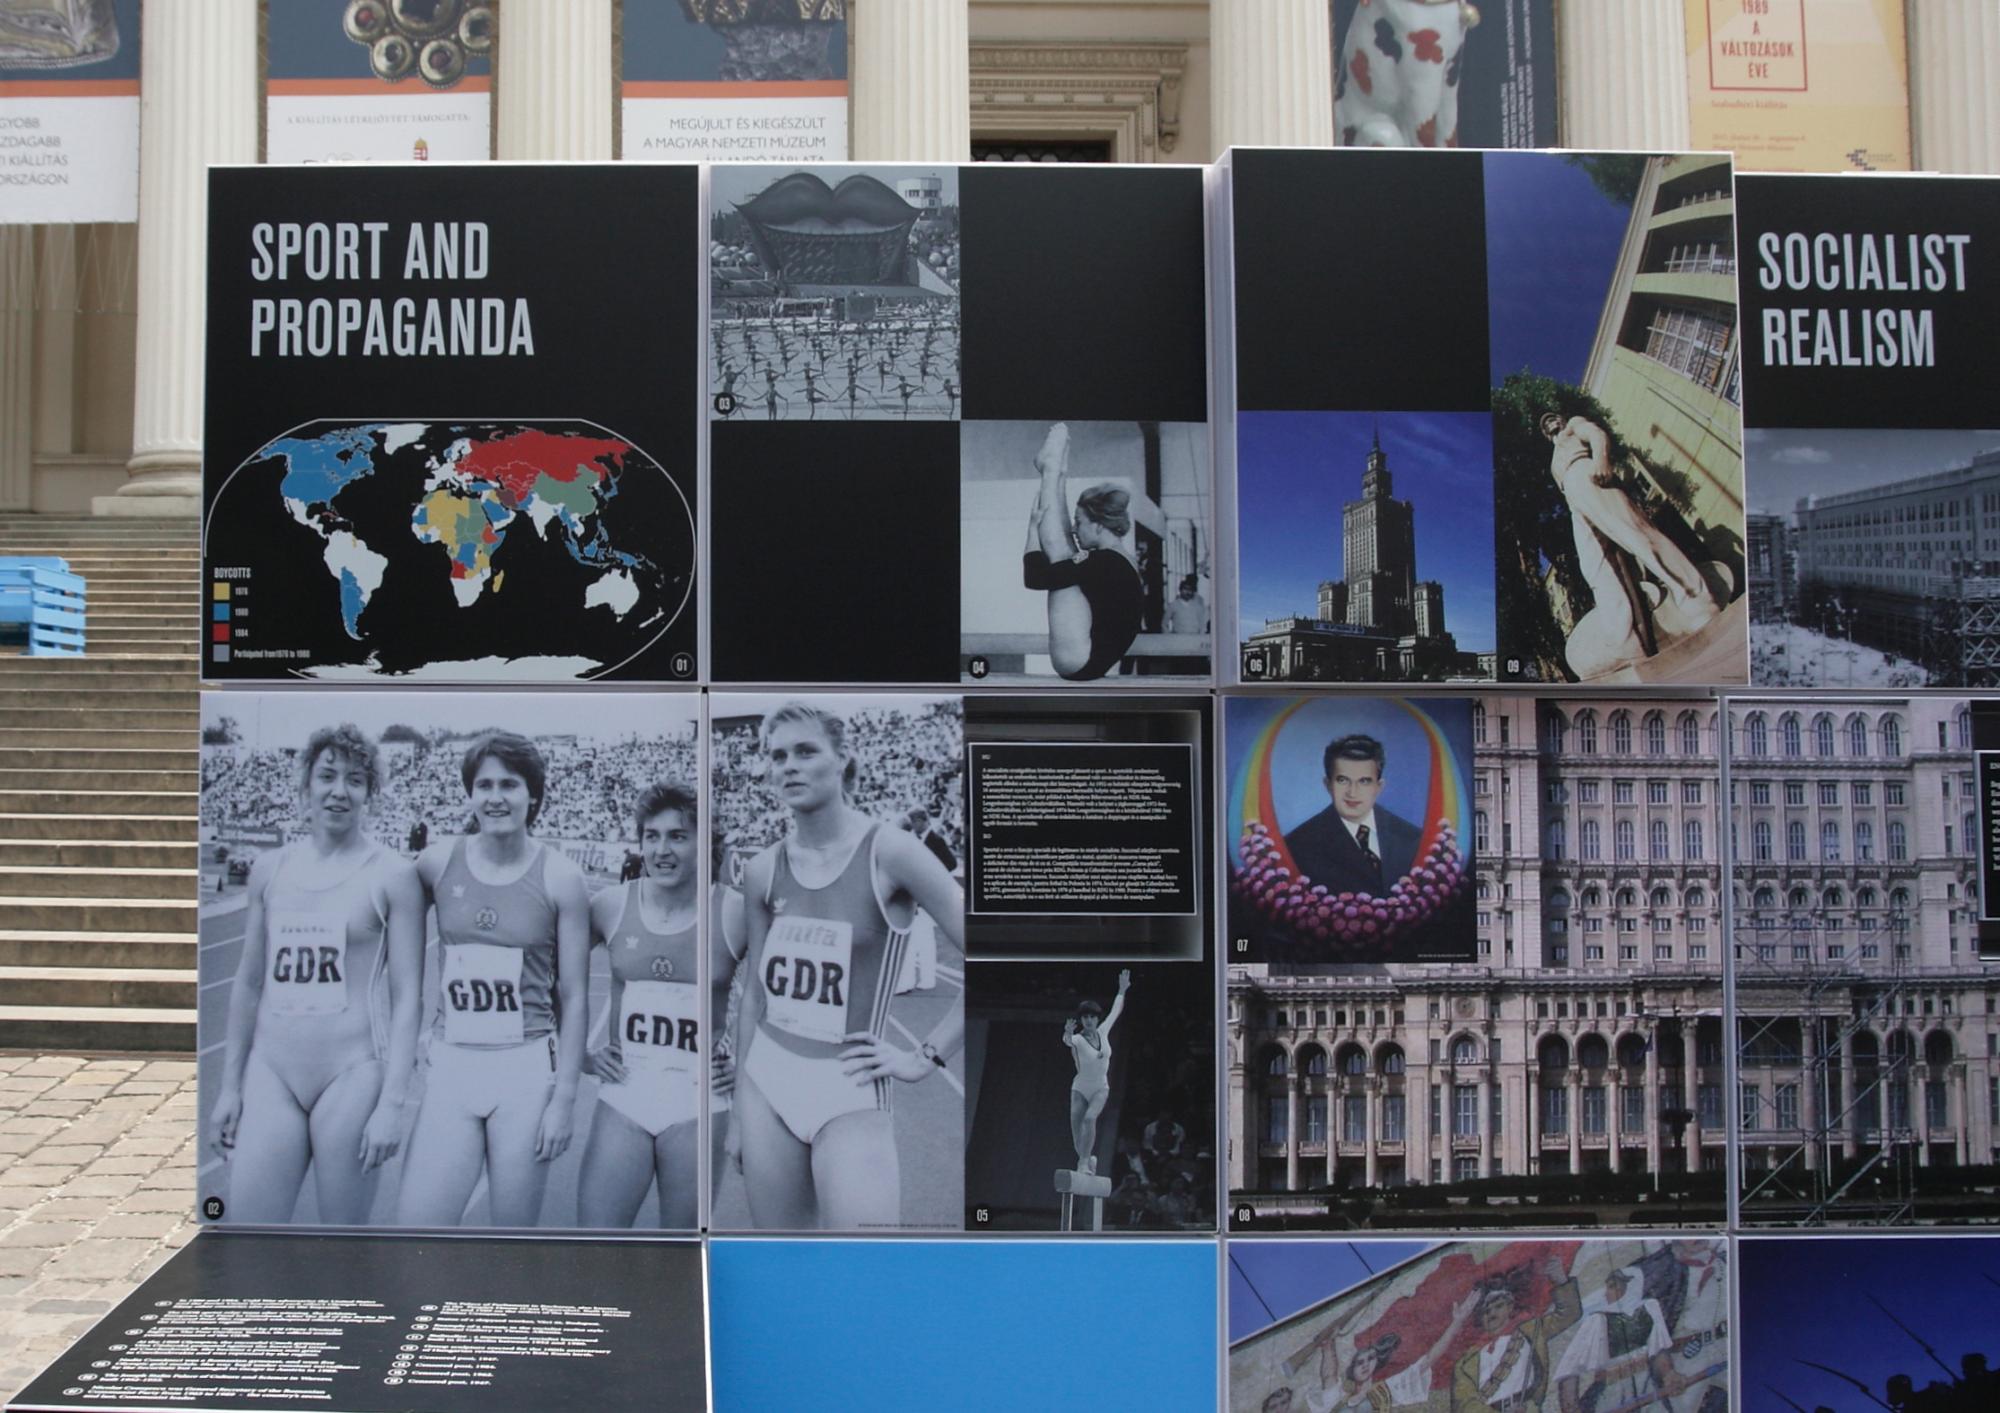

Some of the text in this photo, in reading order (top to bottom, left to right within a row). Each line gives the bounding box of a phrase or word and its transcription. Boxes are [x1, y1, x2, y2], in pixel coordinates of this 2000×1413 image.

[1752, 20, 1760, 35] A
[1721, 38, 1794, 57] VÁLTOZÁSOK
[670, 115, 826, 131] MEGÚJULT ÉS KIEGÉSZÜLT
[643, 135, 826, 148] A MAGYAR NEMZETI MÚZEUM
[251, 222, 489, 281] SPORT AND
[1758, 232, 1971, 292] SOCIALIST
[251, 297, 535, 357] PROPAGANDA
[1762, 308, 1936, 367] REALISM
[214, 567, 251, 579] BOYCOTTS
[676, 658, 688, 671] 01
[1250, 658, 1263, 672] 06
[1236, 939, 1249, 952] 07
[273, 946, 342, 983] GDR
[765, 955, 844, 1007] GDR
[448, 979, 519, 1012] GDR
[626, 1012, 698, 1054] GDR
[208, 1202, 220, 1215] 02
[976, 1208, 989, 1222] 05
[1239, 1208, 1251, 1222] 08
